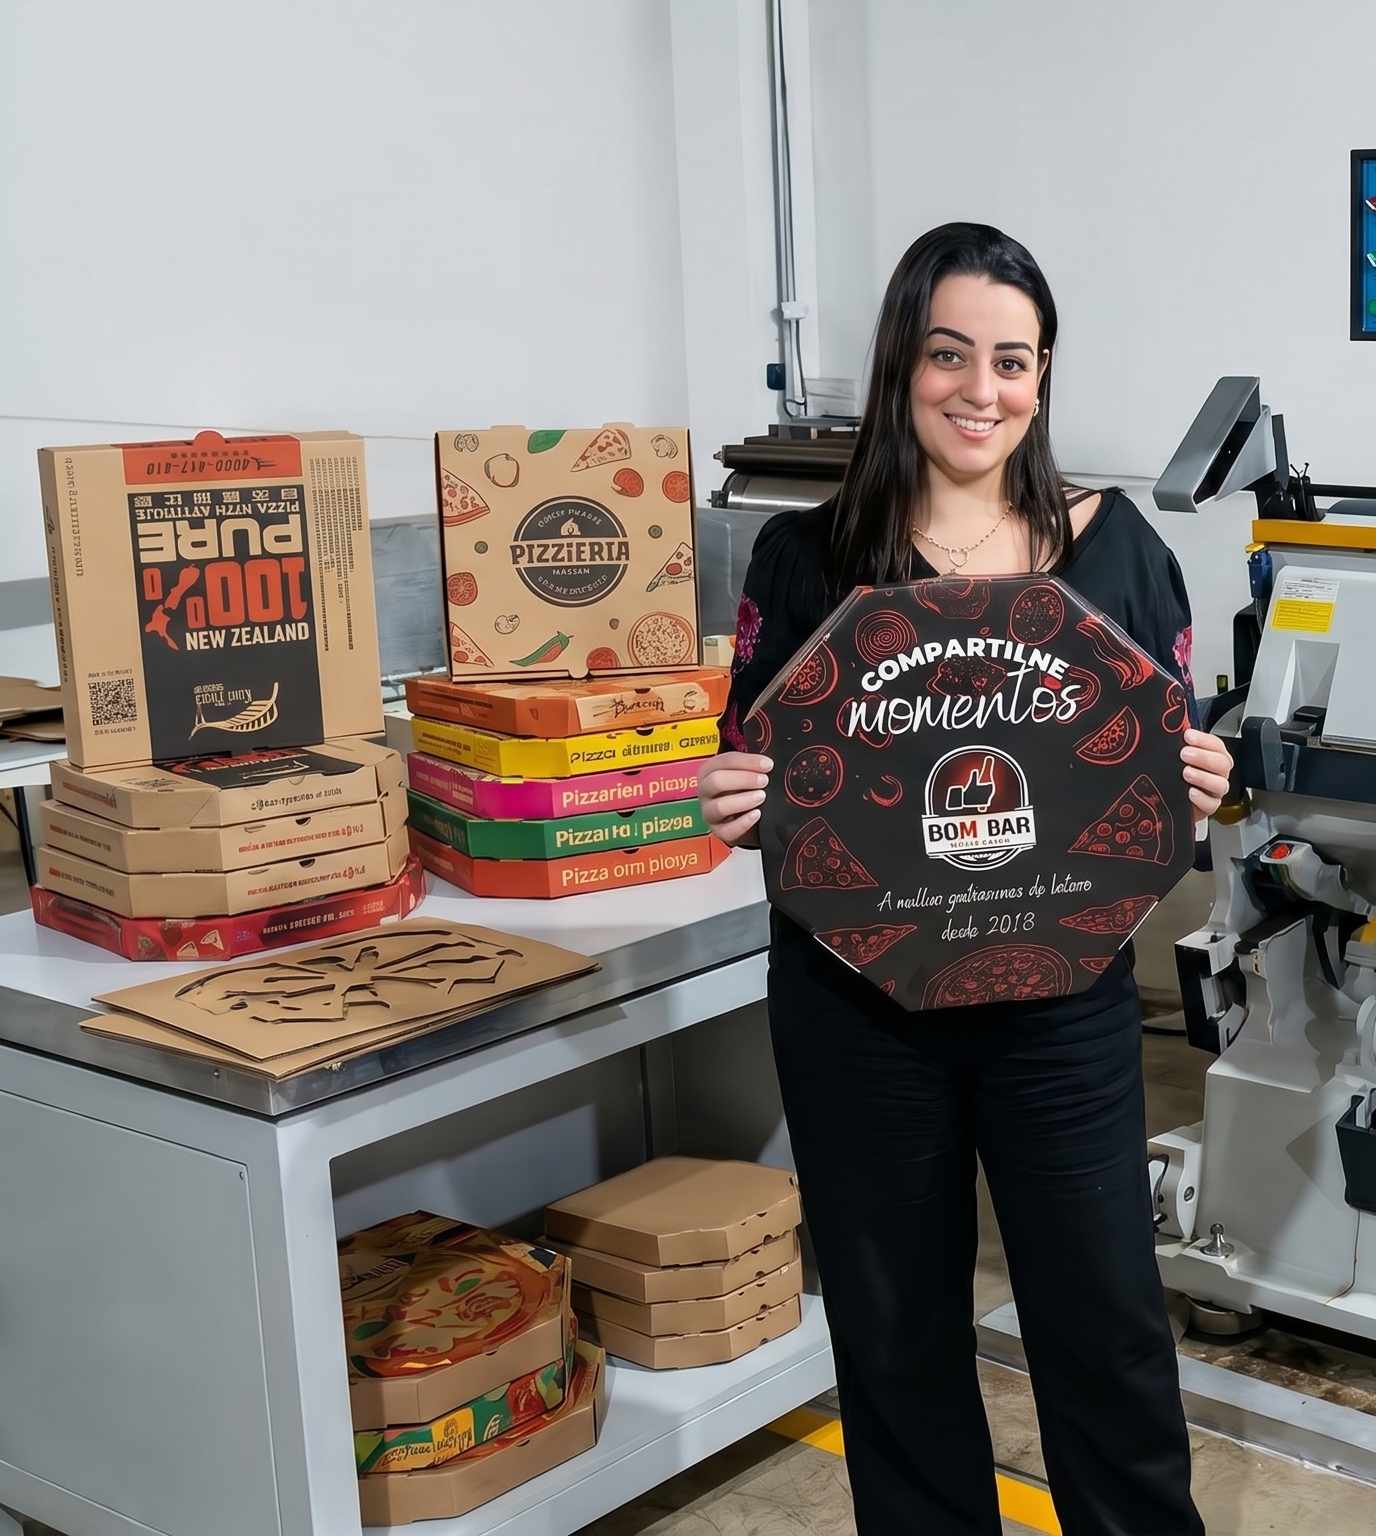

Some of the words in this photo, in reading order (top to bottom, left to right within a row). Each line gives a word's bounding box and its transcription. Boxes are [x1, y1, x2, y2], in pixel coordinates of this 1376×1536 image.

[136, 514, 304, 564] PURE
[185, 629, 226, 651] NEW
[230, 622, 310, 647] ZEALAND
[861, 637, 1071, 692] COMPARTILNE
[847, 661, 1082, 737] momentos
[562, 782, 643, 808] Pizzarien
[928, 820, 978, 842] BOM
[987, 816, 1031, 837] BAR
[561, 867, 609, 887] Pizza
[876, 890, 893, 912] A
[985, 911, 1036, 936] 2018
